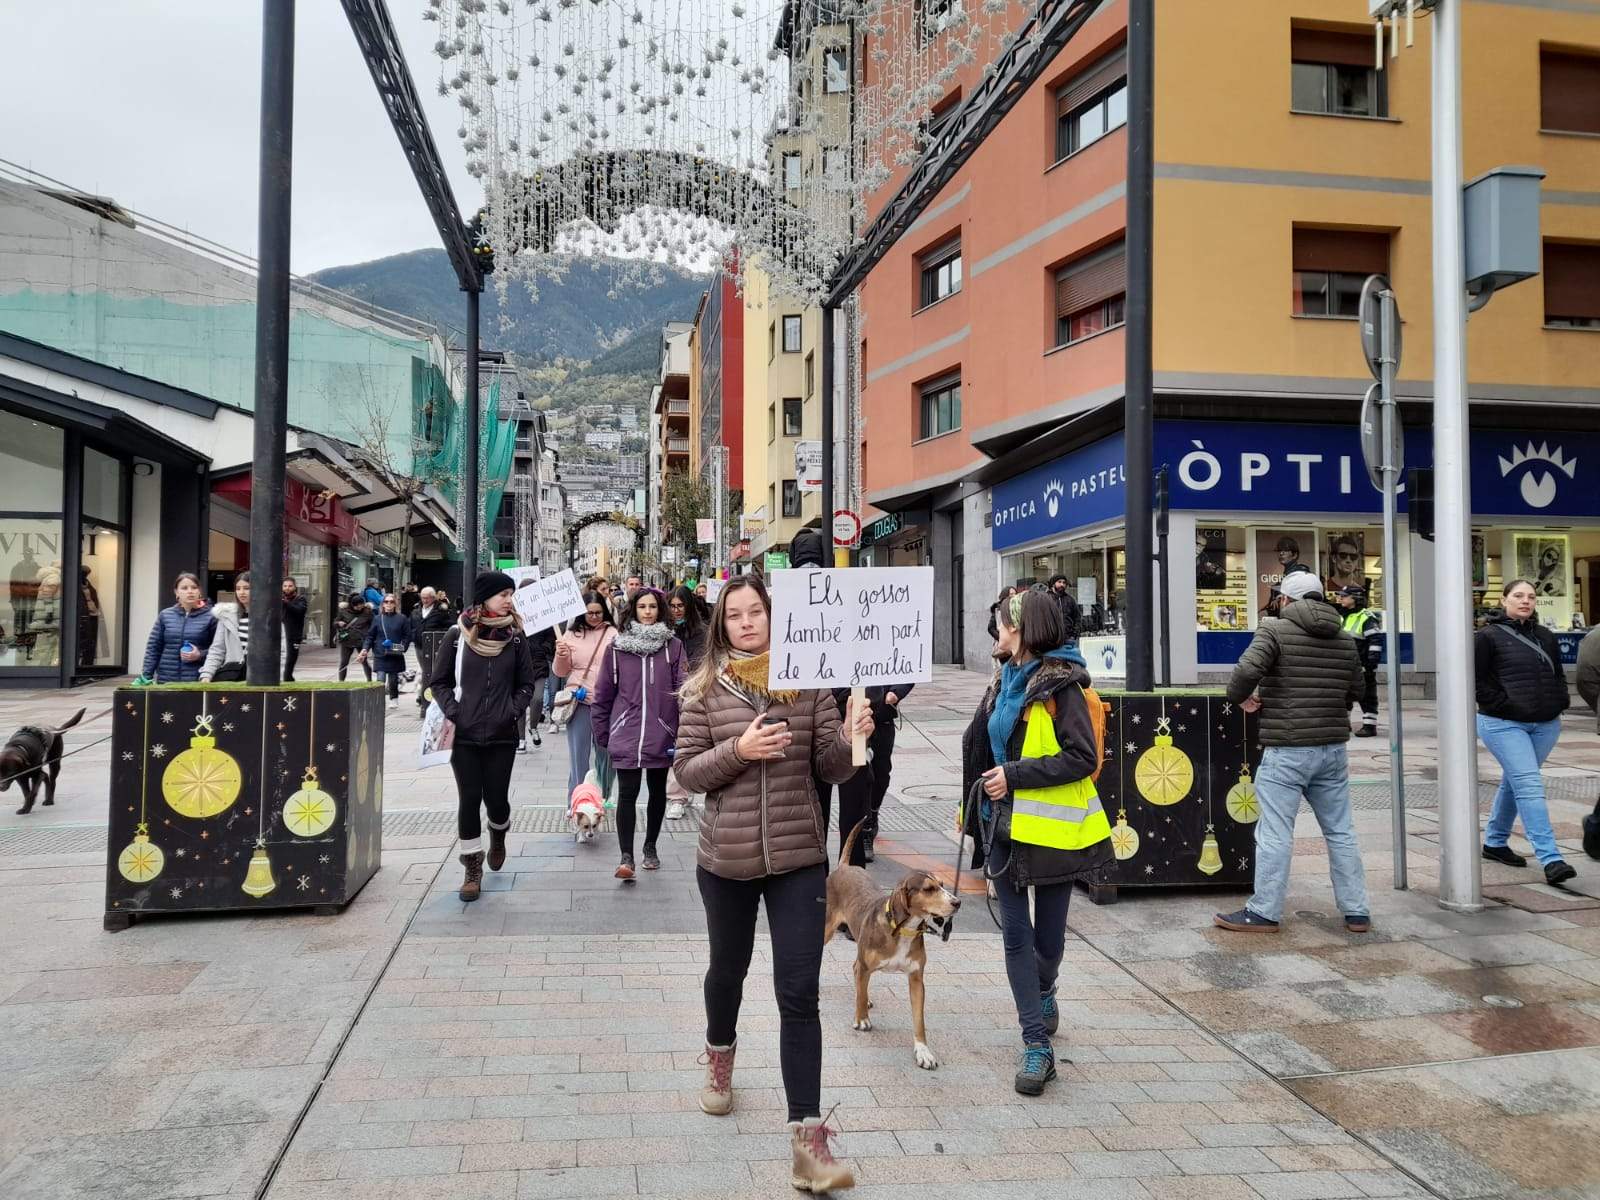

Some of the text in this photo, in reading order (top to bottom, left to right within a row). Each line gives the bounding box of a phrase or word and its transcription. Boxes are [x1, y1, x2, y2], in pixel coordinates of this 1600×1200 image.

[1178, 440, 1406, 494] ÒPTI
[995, 464, 1126, 527] ÒPTICA PASTEU
[874, 513, 898, 540] DOUGLAS
[1197, 530, 1225, 538] CCI
[809, 572, 910, 618] Els gossos
[1261, 574, 1282, 583] GIGI
[1536, 599, 1554, 607] ELINE
[784, 610, 922, 647] també son part
[777, 643, 923, 687] de la família!
